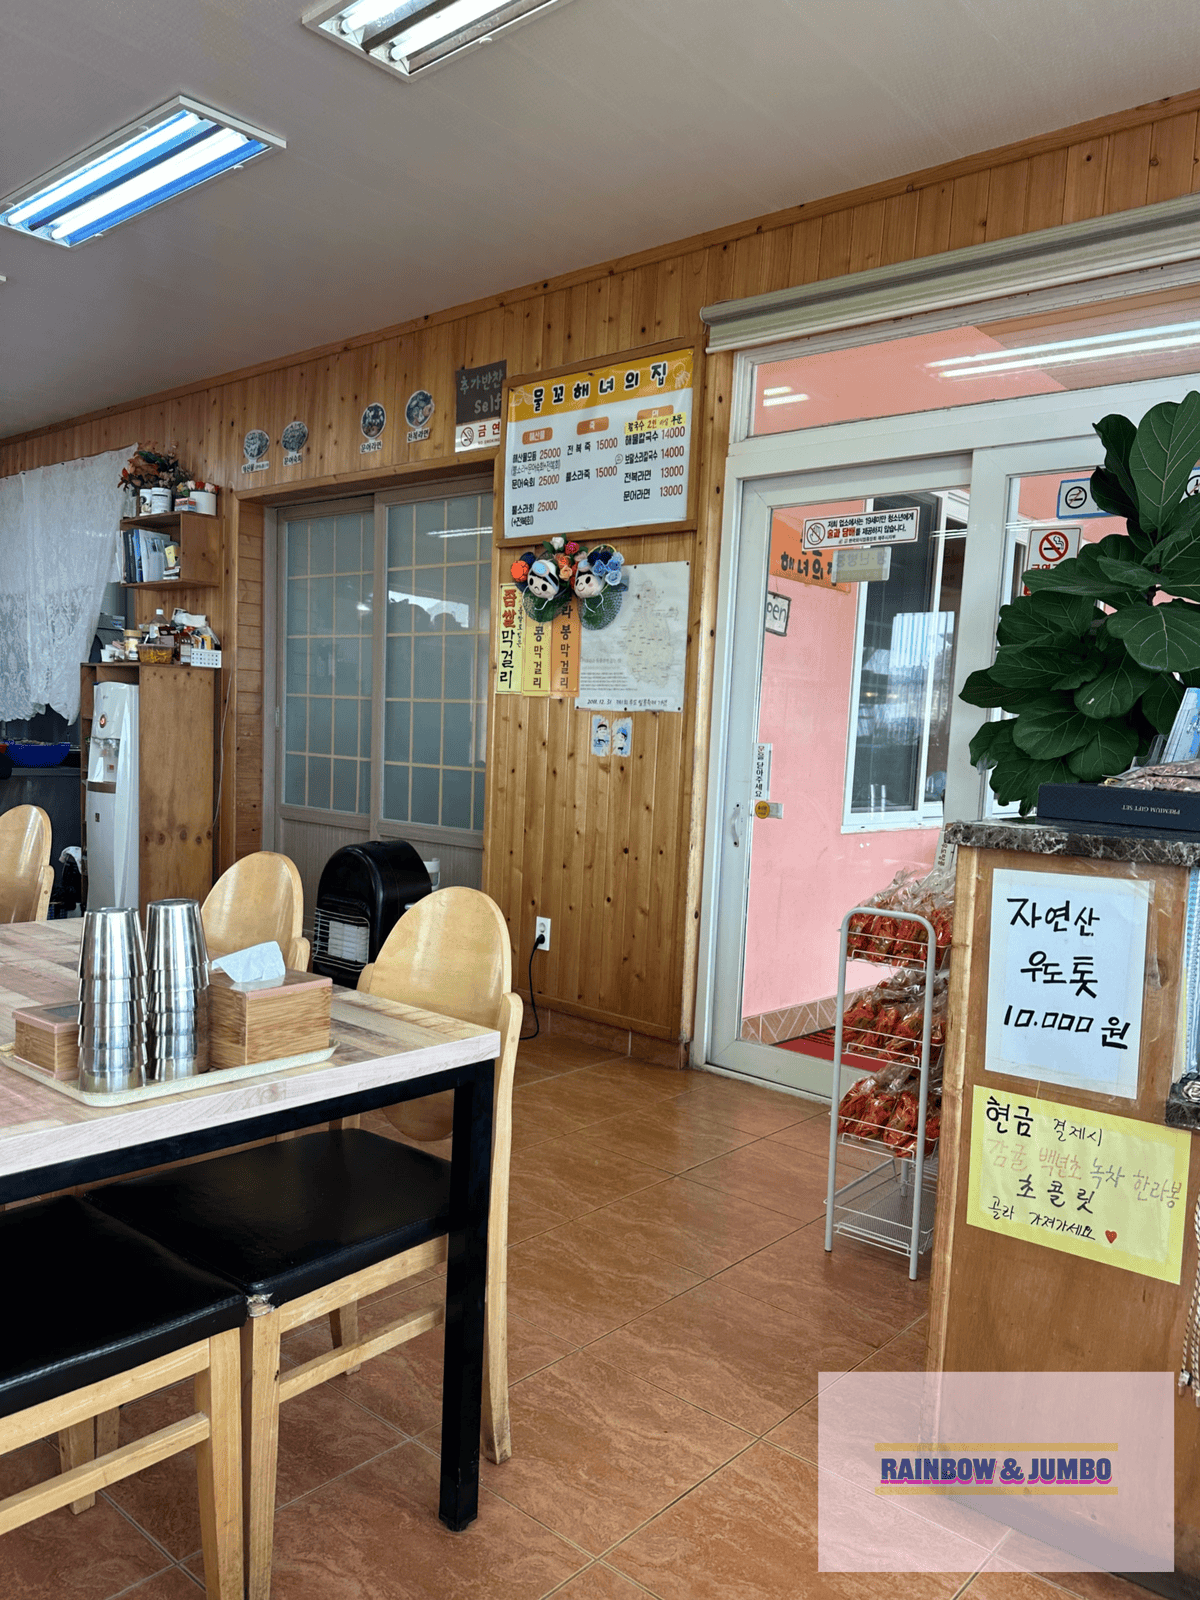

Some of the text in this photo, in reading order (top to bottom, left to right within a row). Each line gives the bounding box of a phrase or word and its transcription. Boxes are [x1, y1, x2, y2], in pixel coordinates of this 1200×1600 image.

[460, 368, 503, 395] 추가반찬
[596, 437, 618, 450] 15000
[625, 426, 685, 446] 해물칼국수 14000
[540, 447, 561, 460] 25000
[661, 445, 684, 459] 14000
[596, 466, 617, 478] 15000
[624, 465, 684, 483] 전복라면 13000
[512, 474, 560, 489] 문어숙회 25000
[623, 484, 683, 502] 문어라면 13000
[537, 500, 558, 512] 25000
[827, 520, 838, 528] 저희
[839, 518, 863, 527] 업소에서는
[888, 512, 914, 522] 청소년에게
[827, 528, 840, 539] 술과
[842, 527, 860, 537] 담배를
[862, 525, 882, 535] 제공하지
[560, 605, 573, 689] 라봉막걸리
[533, 626, 545, 689] 콩막걸리
[1150, 807, 1181, 815] PREMIUM
[1006, 898, 1100, 936] 자연산
[1004, 1004, 1131, 1050] 10.000 원
[986, 1096, 1103, 1146] 현금 결제시
[987, 1138, 1182, 1209] 감귤 백년초 녹차 한라봉
[1016, 1174, 1095, 1214] 초콜릿
[988, 1196, 1096, 1240] 골라 가져가세요
